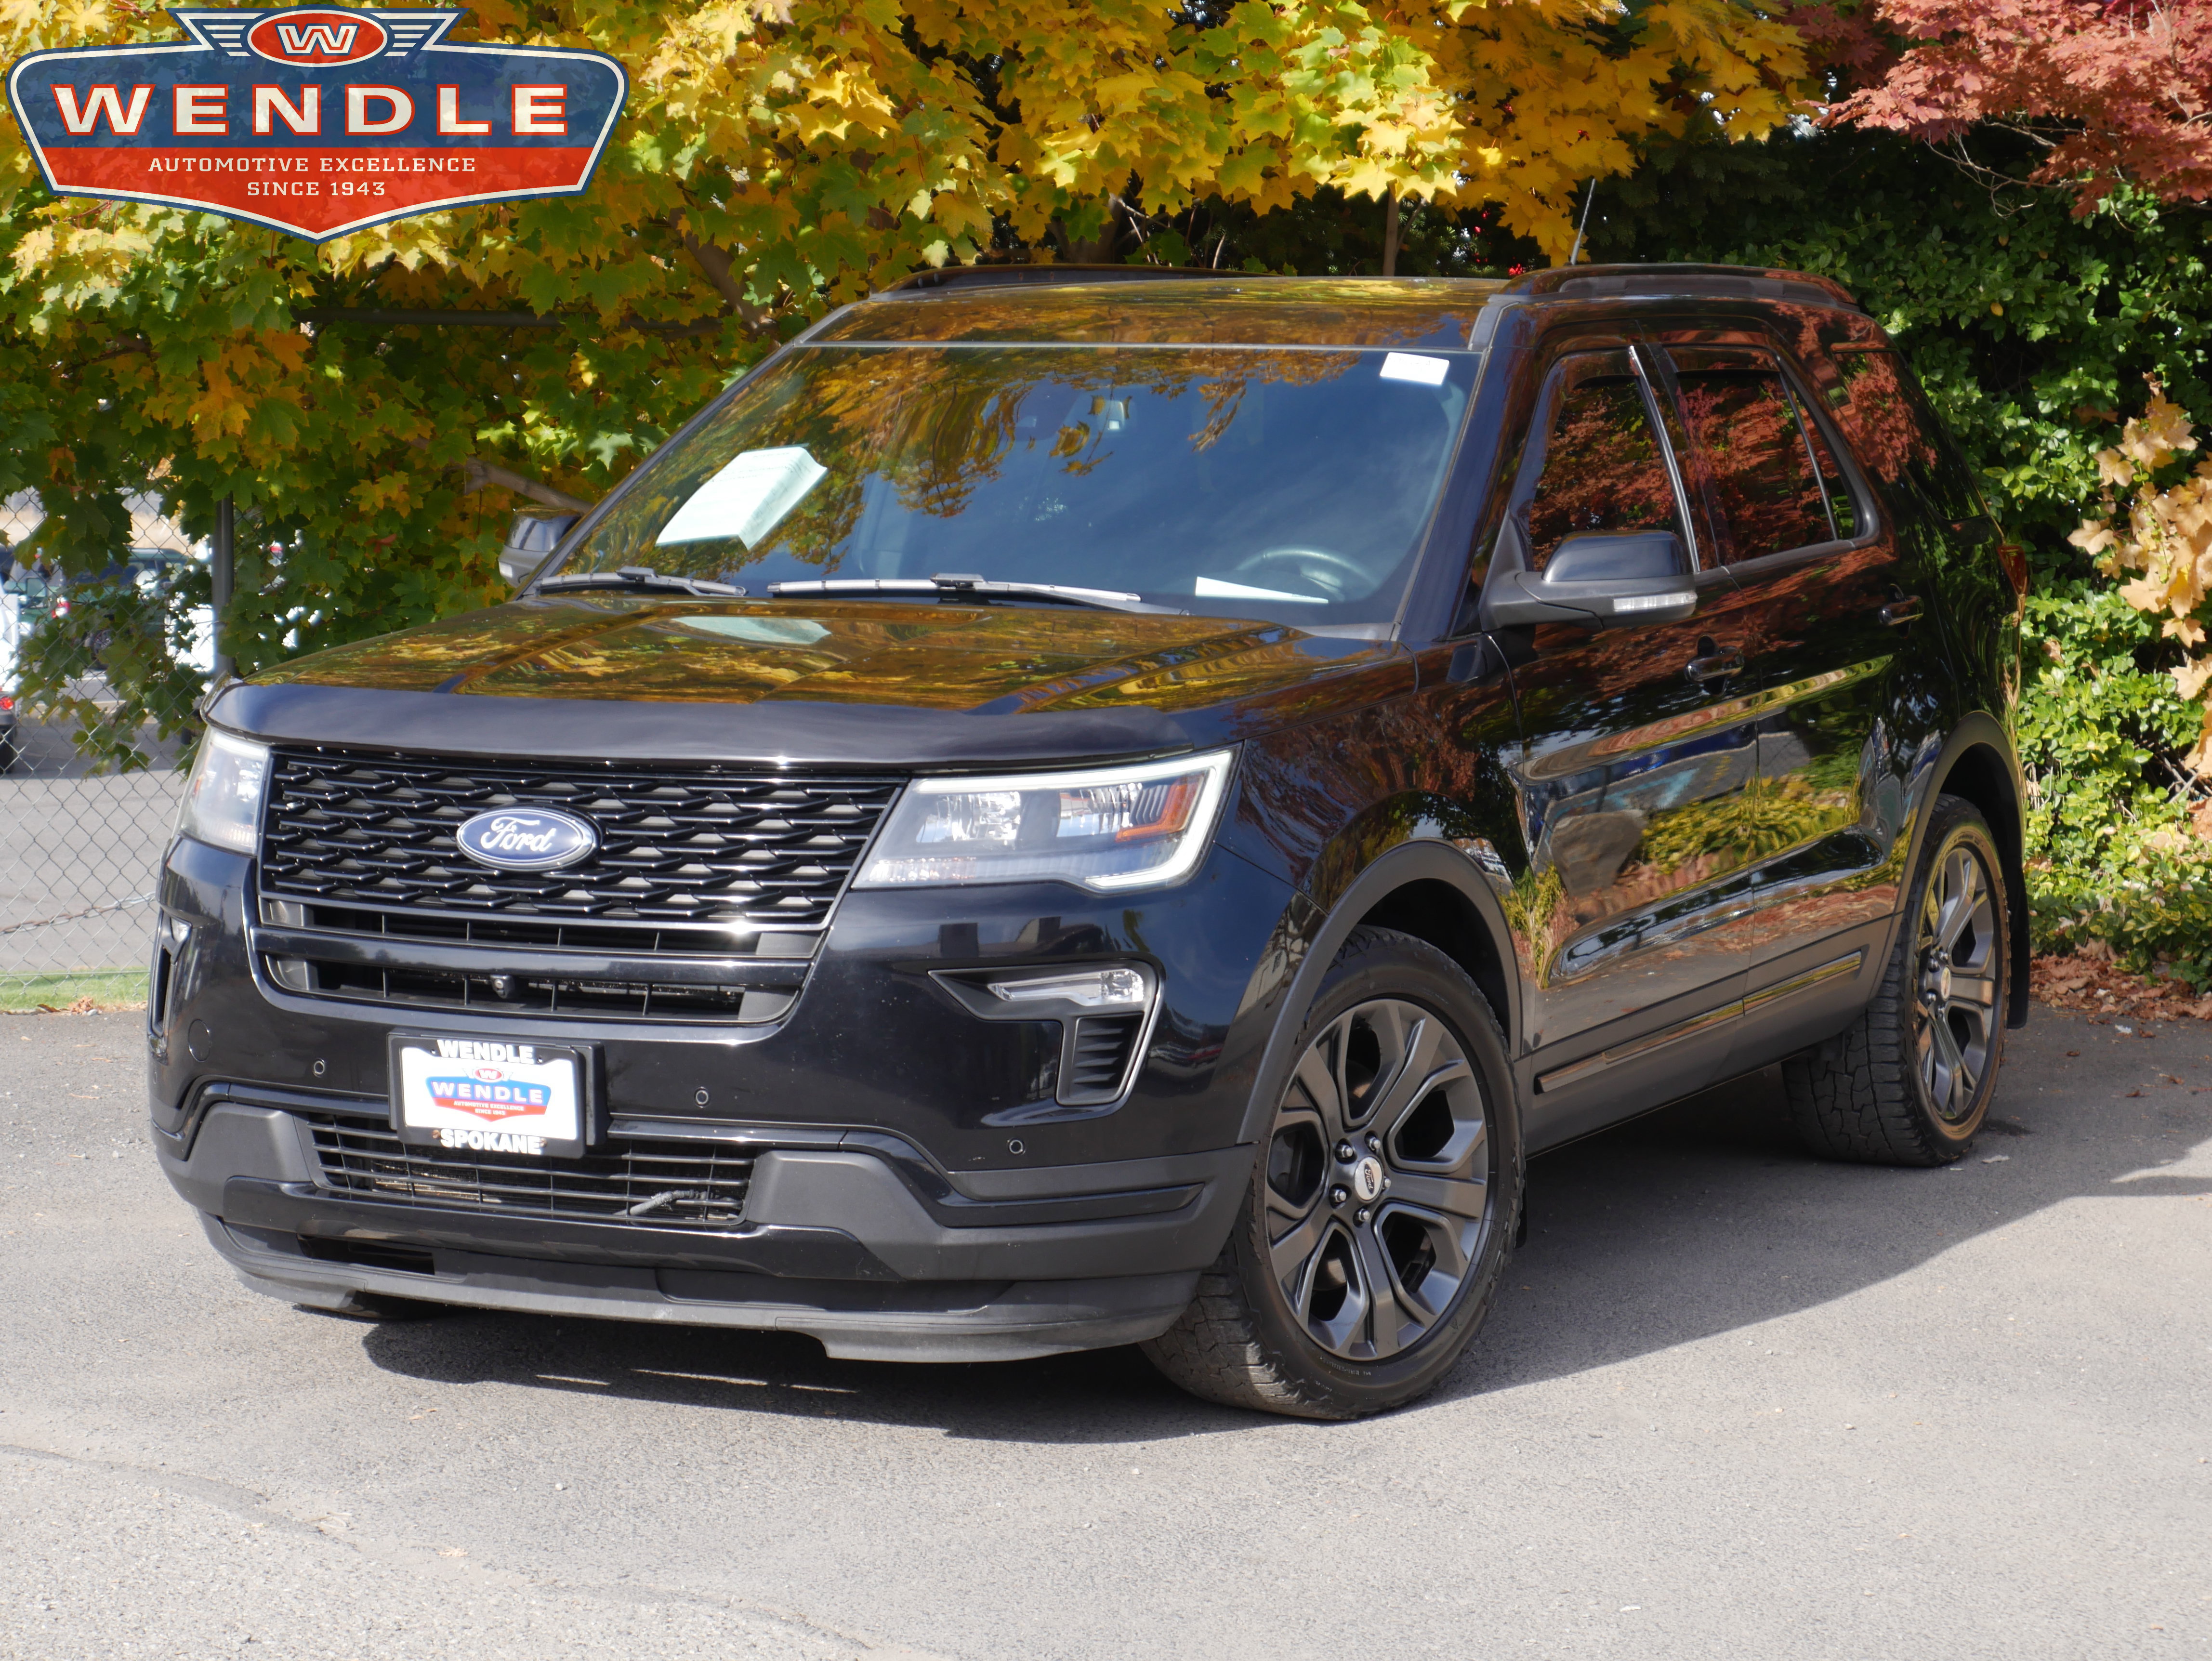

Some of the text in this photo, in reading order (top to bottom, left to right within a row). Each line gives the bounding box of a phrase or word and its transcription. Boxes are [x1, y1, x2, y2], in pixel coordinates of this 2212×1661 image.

[480, 816, 557, 852] Ford
[436, 1039, 535, 1065] WENDLE
[432, 1081, 542, 1103] WENDLE
[440, 1129, 542, 1155] SPOKANE
[1365, 1168, 1374, 1190] Ford
